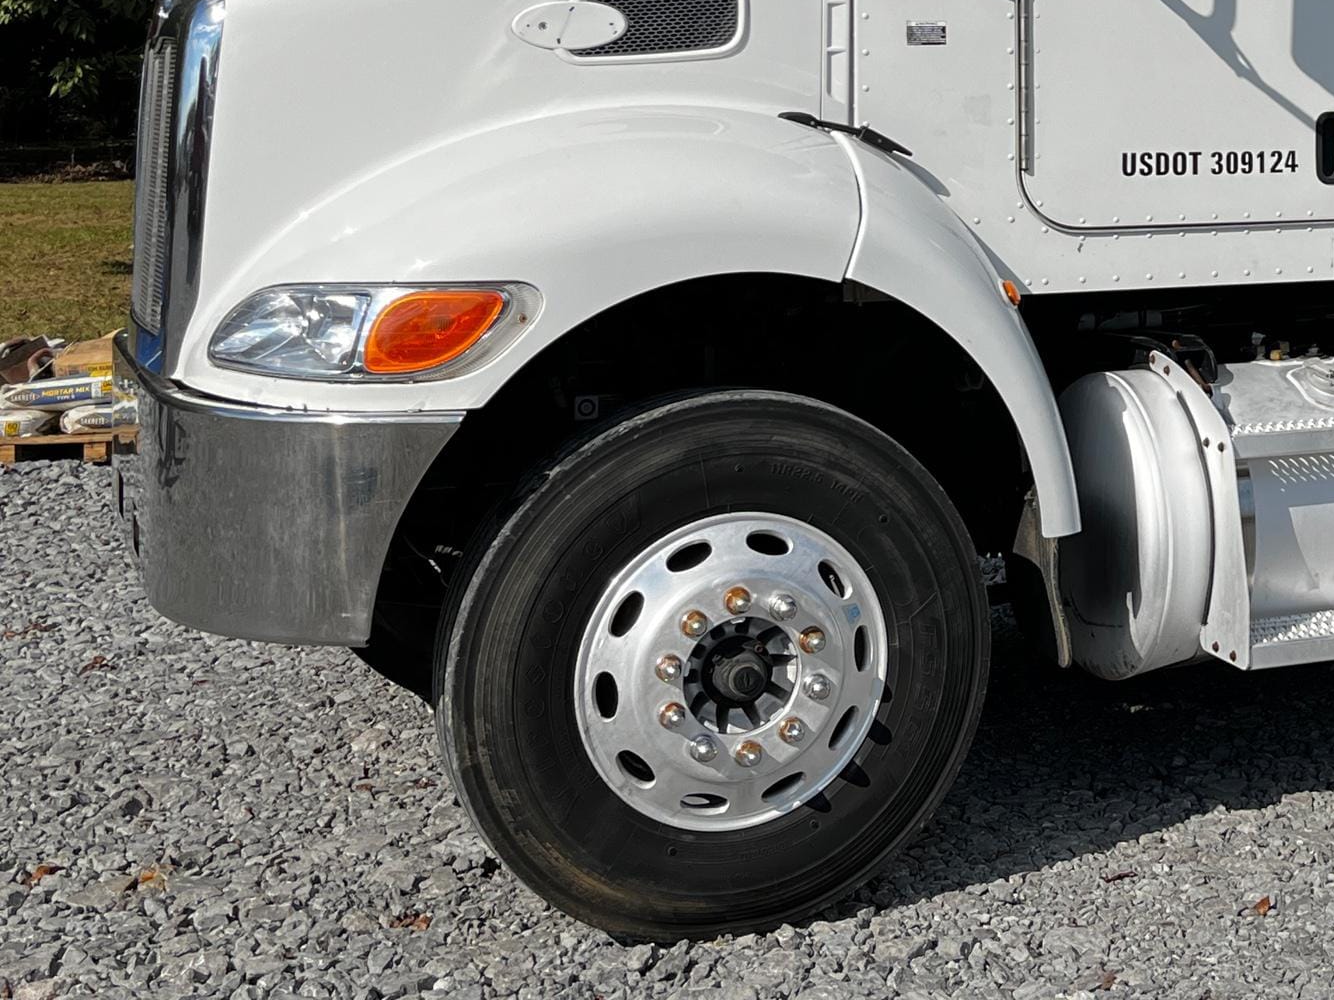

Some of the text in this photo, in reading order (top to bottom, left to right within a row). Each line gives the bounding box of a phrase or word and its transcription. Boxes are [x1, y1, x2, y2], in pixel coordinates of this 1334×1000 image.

[1121, 150, 1299, 176] USDOT 309124
[75, 385, 91, 394] MIX
